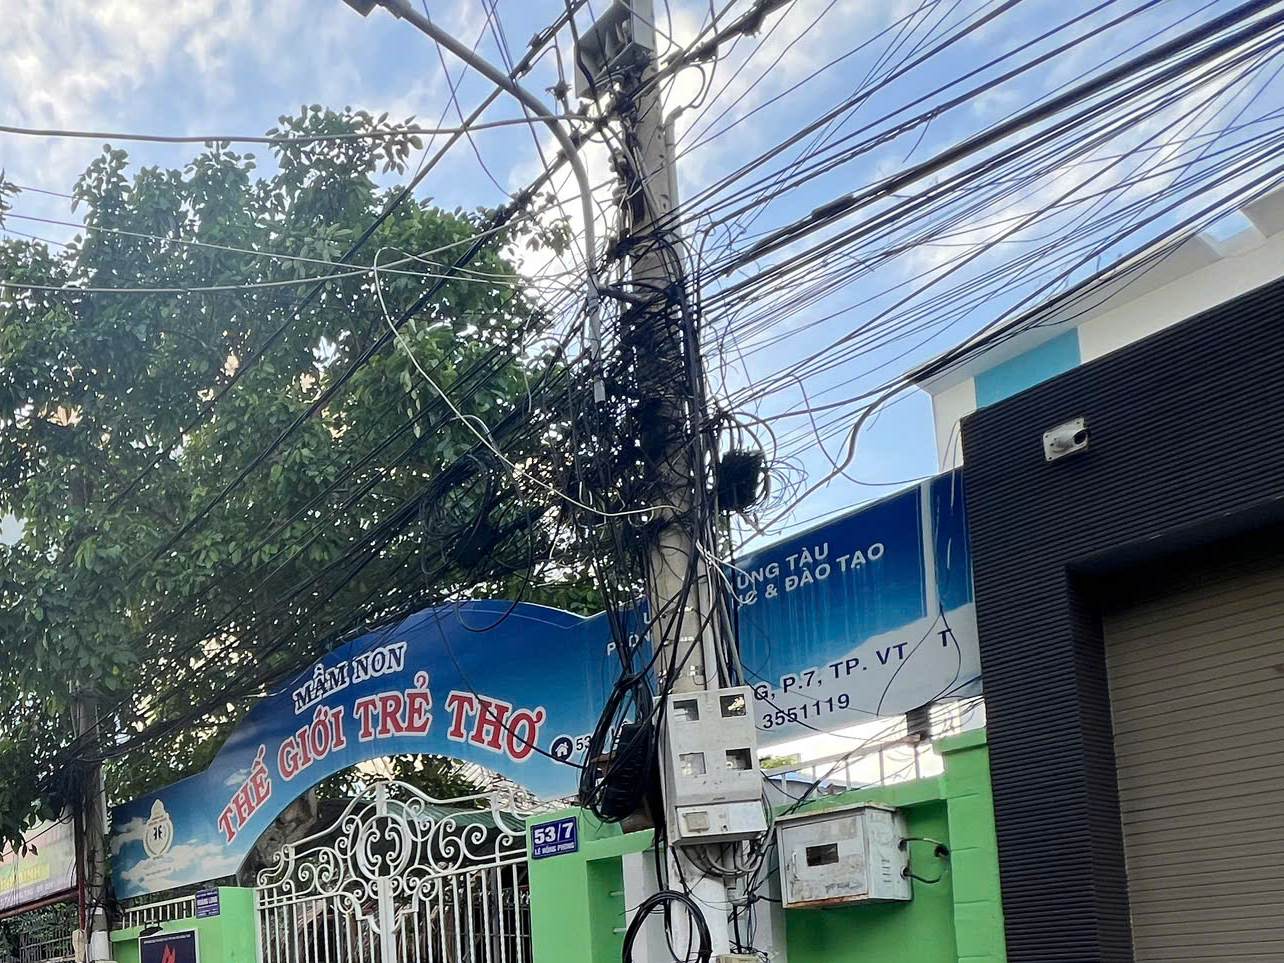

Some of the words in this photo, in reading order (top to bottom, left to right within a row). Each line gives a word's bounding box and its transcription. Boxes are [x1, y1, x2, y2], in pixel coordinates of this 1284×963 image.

[765, 584, 778, 599] &
[785, 564, 831, 592] ĐÀO
[836, 543, 885, 572] TẠO
[786, 543, 829, 571] TÀU
[293, 662, 349, 714] MẦM
[352, 642, 407, 684] NON
[829, 657, 867, 679] TP.
[876, 642, 908, 665] VT
[762, 693, 850, 729] 3551119
[218, 744, 272, 844] THẾ
[278, 706, 347, 782] GIỚI
[355, 671, 432, 740] TRẺ
[444, 690, 546, 762] THƠ
[534, 822, 573, 844] 53/7
